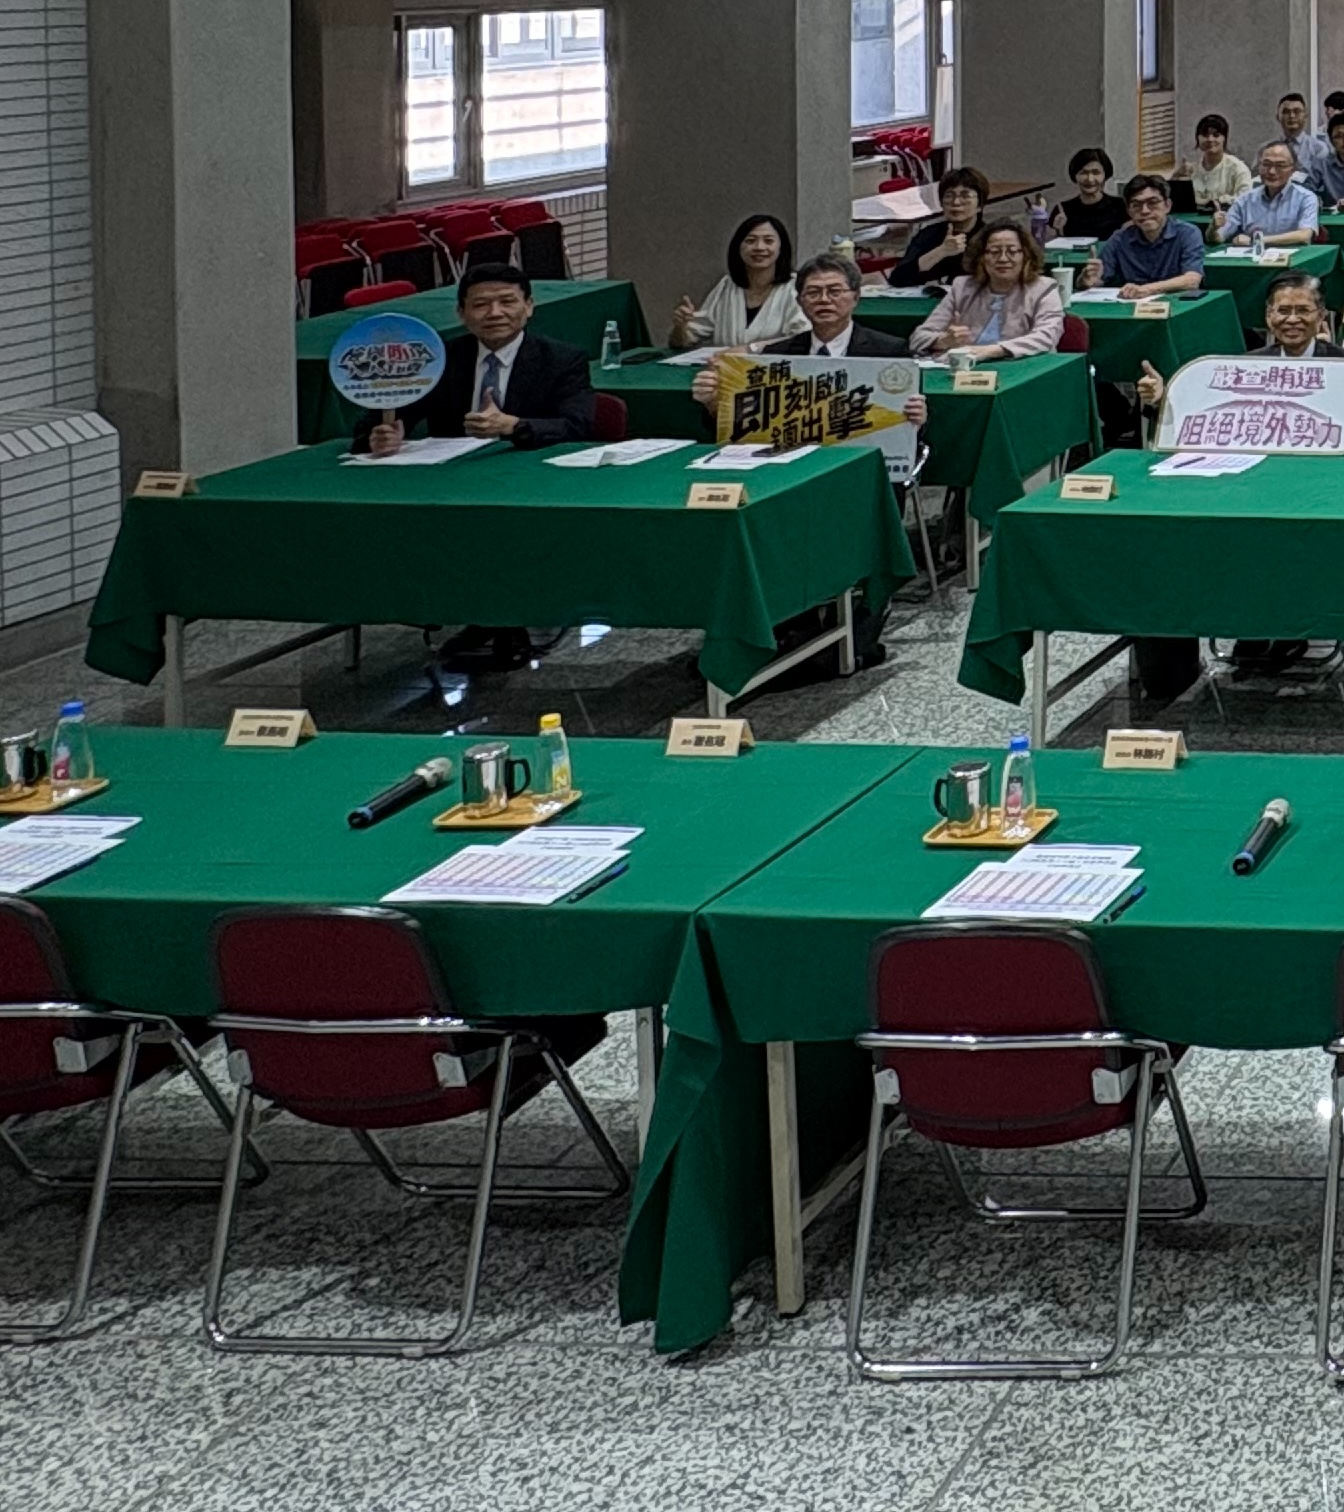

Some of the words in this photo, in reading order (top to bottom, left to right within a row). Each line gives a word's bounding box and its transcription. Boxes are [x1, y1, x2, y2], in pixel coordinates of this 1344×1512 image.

[1176, 411, 1343, 448] 阻絕境外勢力
